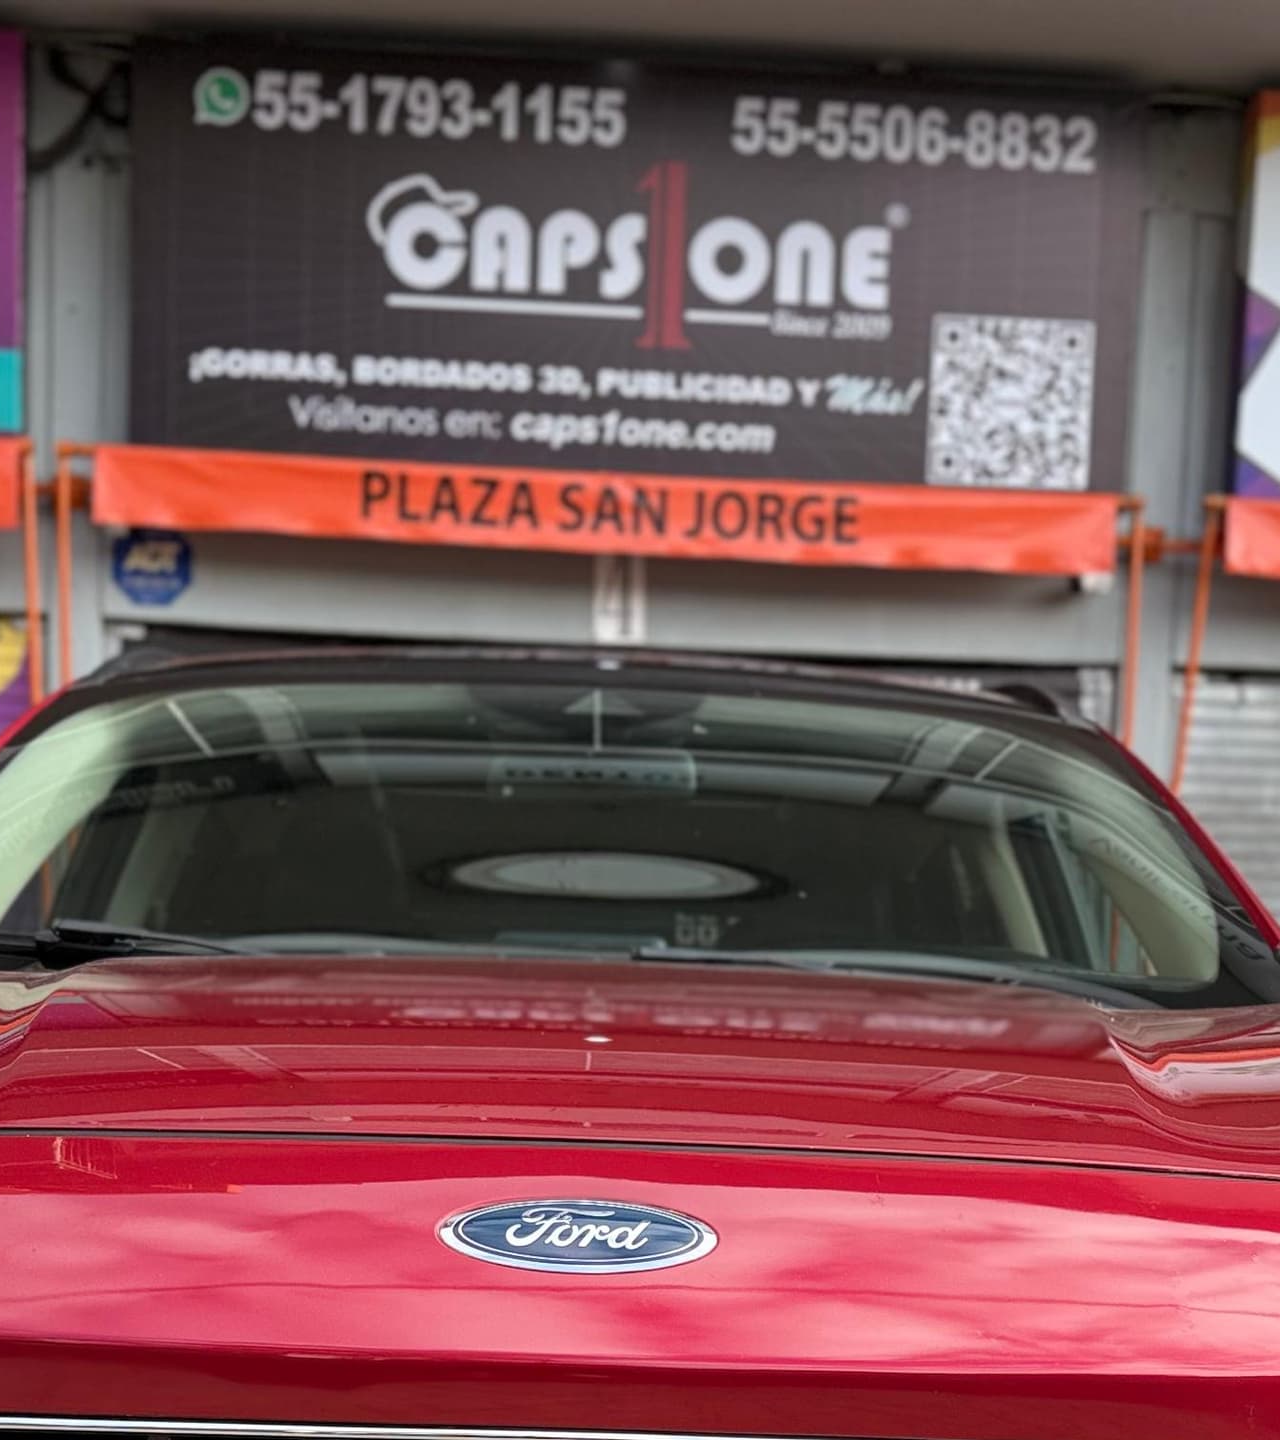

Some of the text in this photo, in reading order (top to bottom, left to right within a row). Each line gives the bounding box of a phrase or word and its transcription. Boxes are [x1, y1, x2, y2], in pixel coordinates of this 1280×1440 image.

[252, 69, 627, 148] 55-1793-1155
[730, 96, 1096, 174] 55-5506-8832
[352, 354, 533, 393] BORDADOS
[597, 367, 793, 408] PUBLICIDAD
[796, 379, 823, 408] Y
[360, 469, 860, 545] PLAZA SAN JORGE
[505, 1207, 653, 1251] Ford
